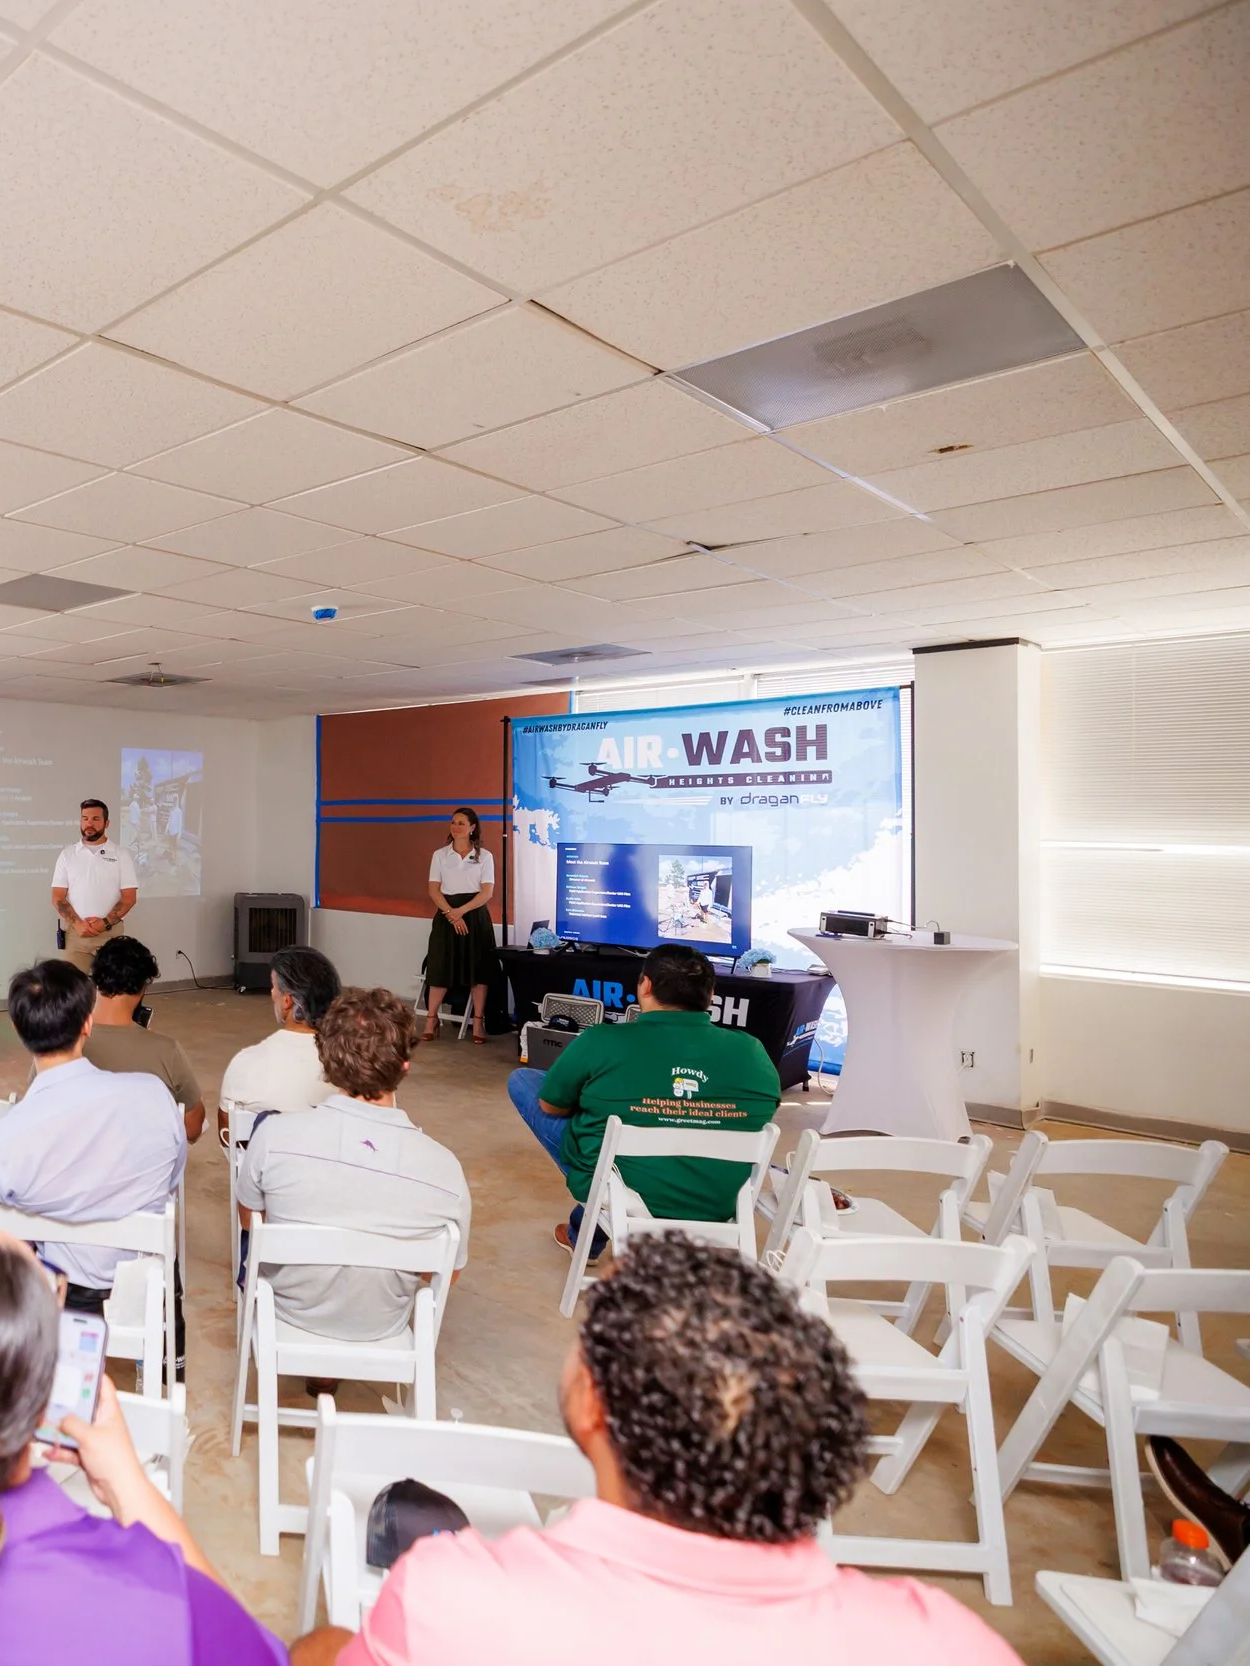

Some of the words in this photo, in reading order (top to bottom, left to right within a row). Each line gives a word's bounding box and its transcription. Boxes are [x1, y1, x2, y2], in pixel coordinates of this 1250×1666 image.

[783, 699, 883, 716] #CLEANFROMABOVE
[523, 721, 608, 734] #AIRWASHBYDRAGANFLY
[682, 723, 827, 767] WASH
[669, 776, 734, 786] HEIGHTS
[720, 797, 734, 805] BY
[573, 978, 624, 1008] AIR
[707, 995, 750, 1027] SH
[671, 1066, 709, 1083] Howdy
[642, 1097, 682, 1108] Helping
[683, 1100, 736, 1109] businesses
[630, 1104, 659, 1114] reach
[662, 1107, 687, 1116] their
[689, 1108, 713, 1117] ideal
[715, 1110, 747, 1118] clients
[658, 1117, 721, 1125] www.greetmag.com
